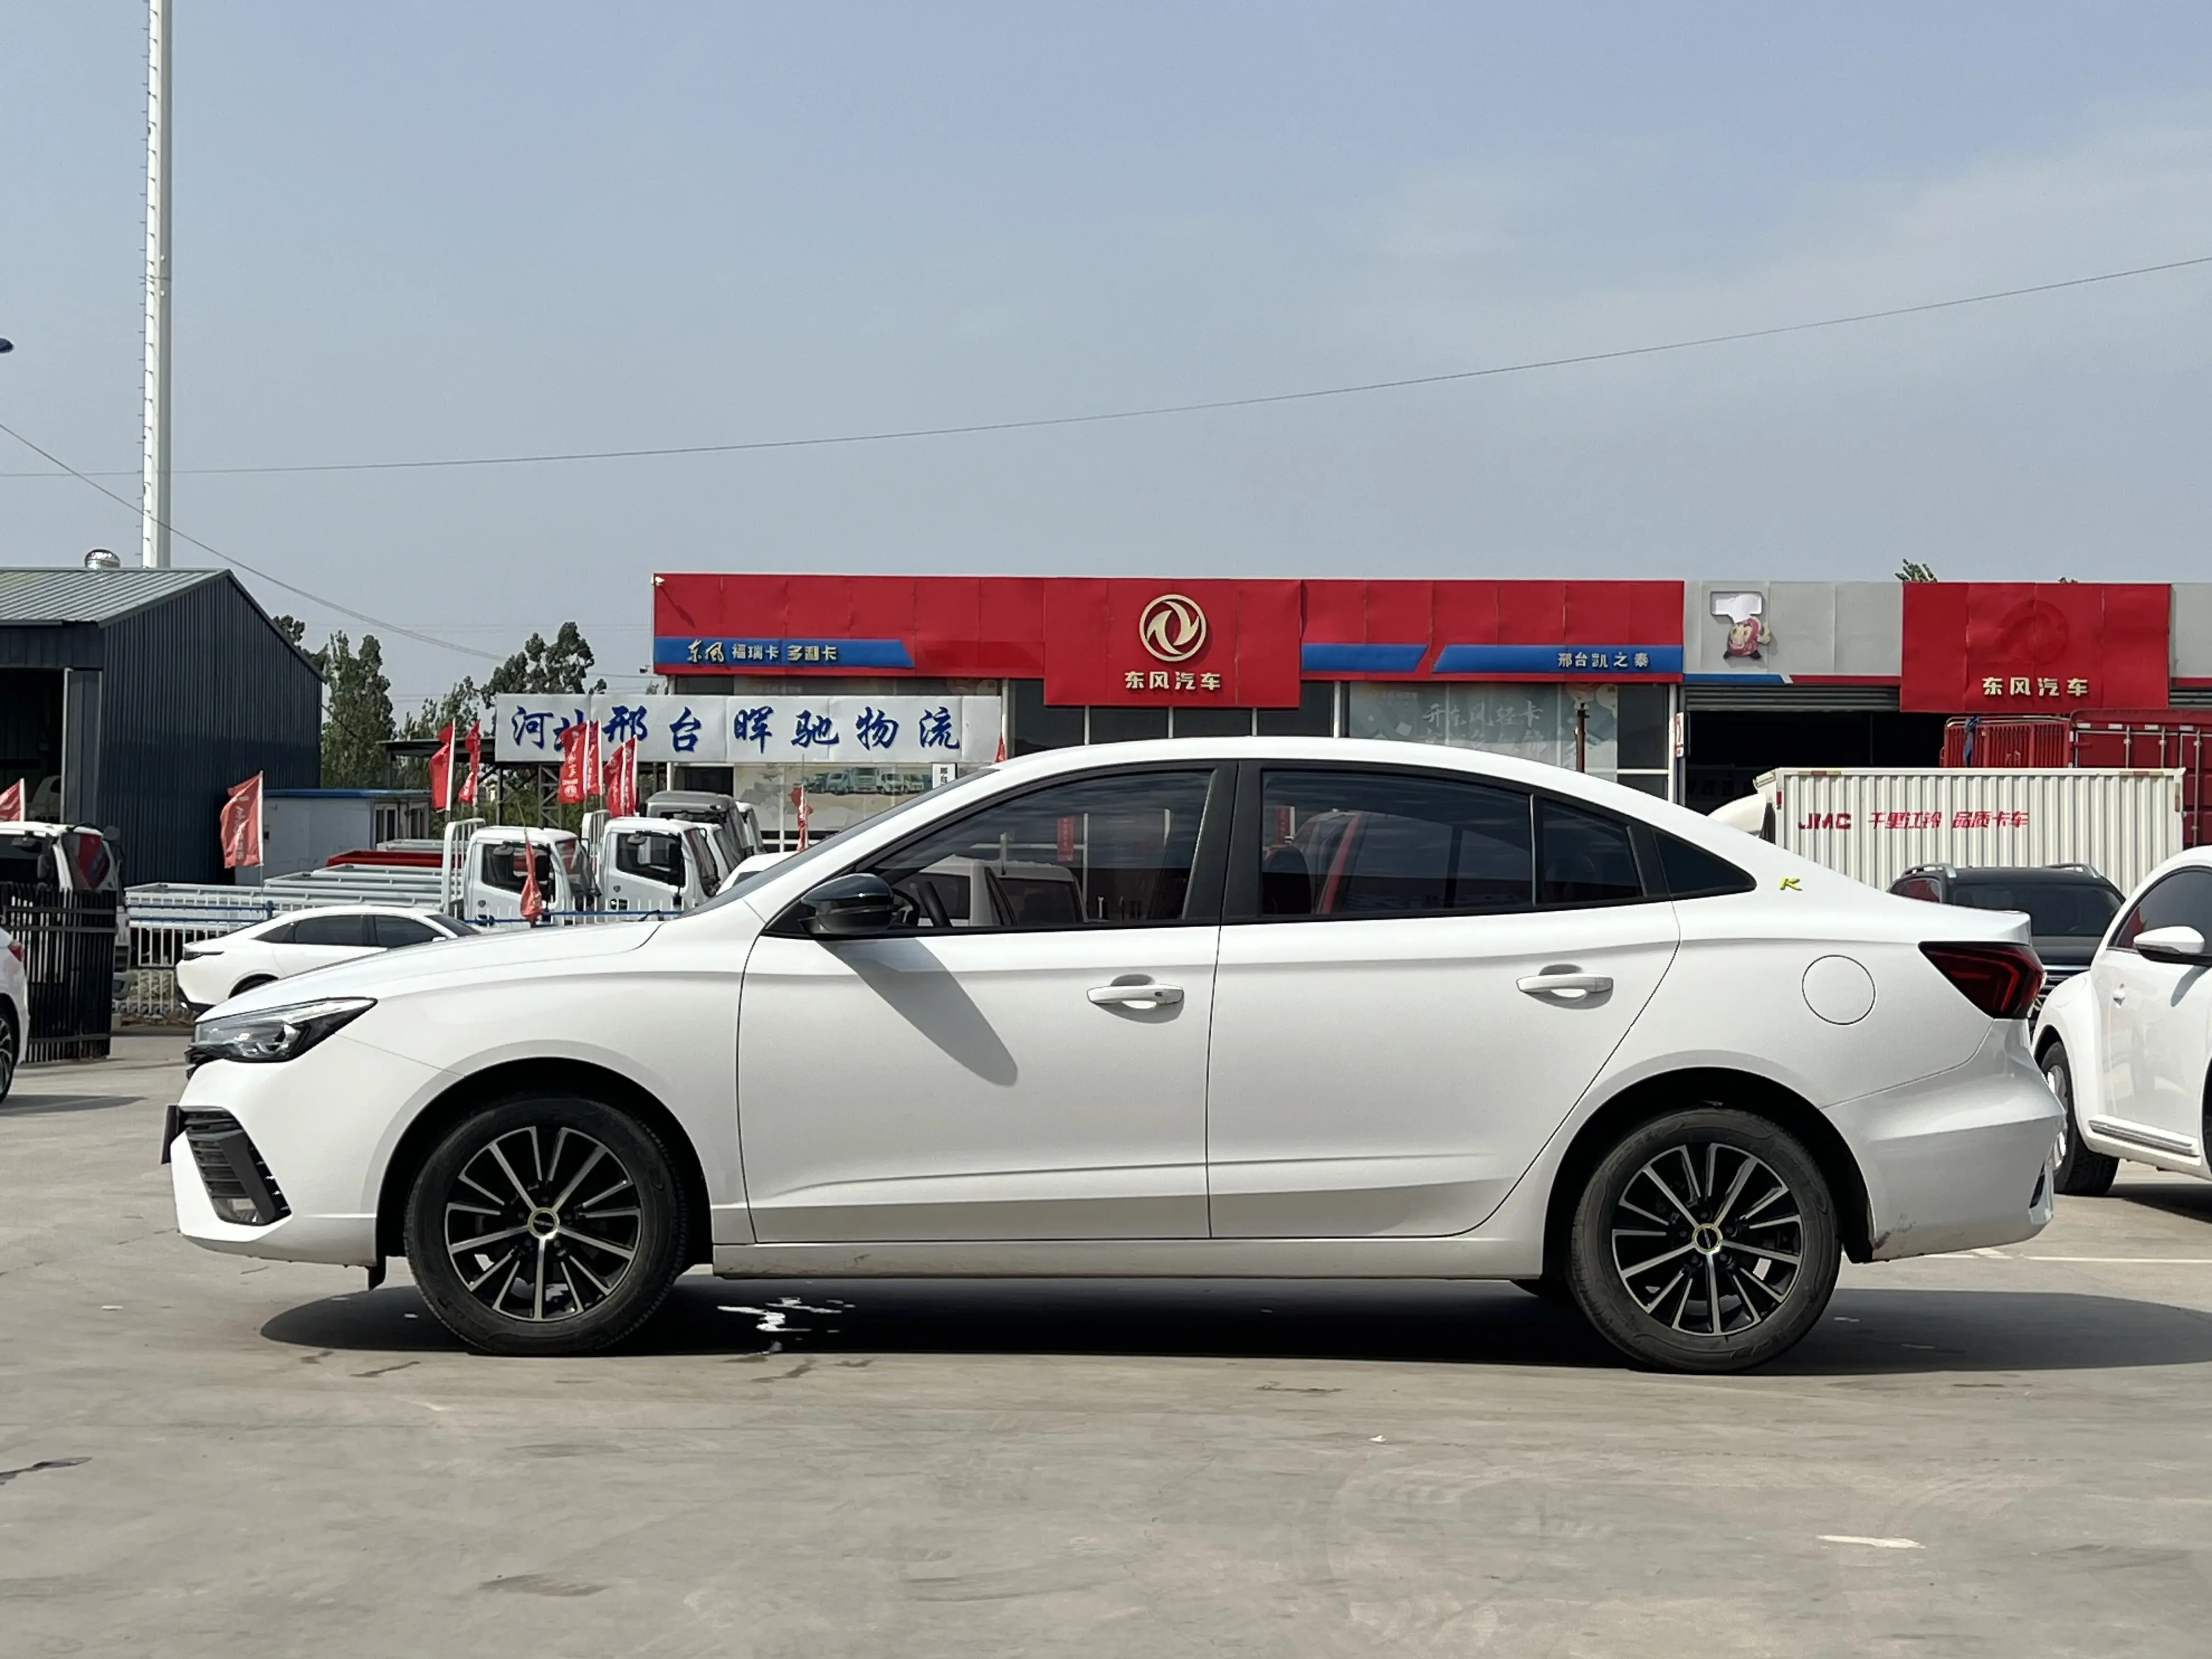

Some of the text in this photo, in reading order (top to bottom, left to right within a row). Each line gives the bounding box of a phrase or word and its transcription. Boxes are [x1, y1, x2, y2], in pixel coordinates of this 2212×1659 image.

[687, 639, 725, 662] 东风
[732, 643, 779, 660] 福瑞卡
[1124, 671, 1221, 690] 东风汽车
[1982, 676, 2088, 697] 东风汽车
[1798, 812, 1852, 830] JMC
[1951, 811, 2029, 829] 品质卡车
